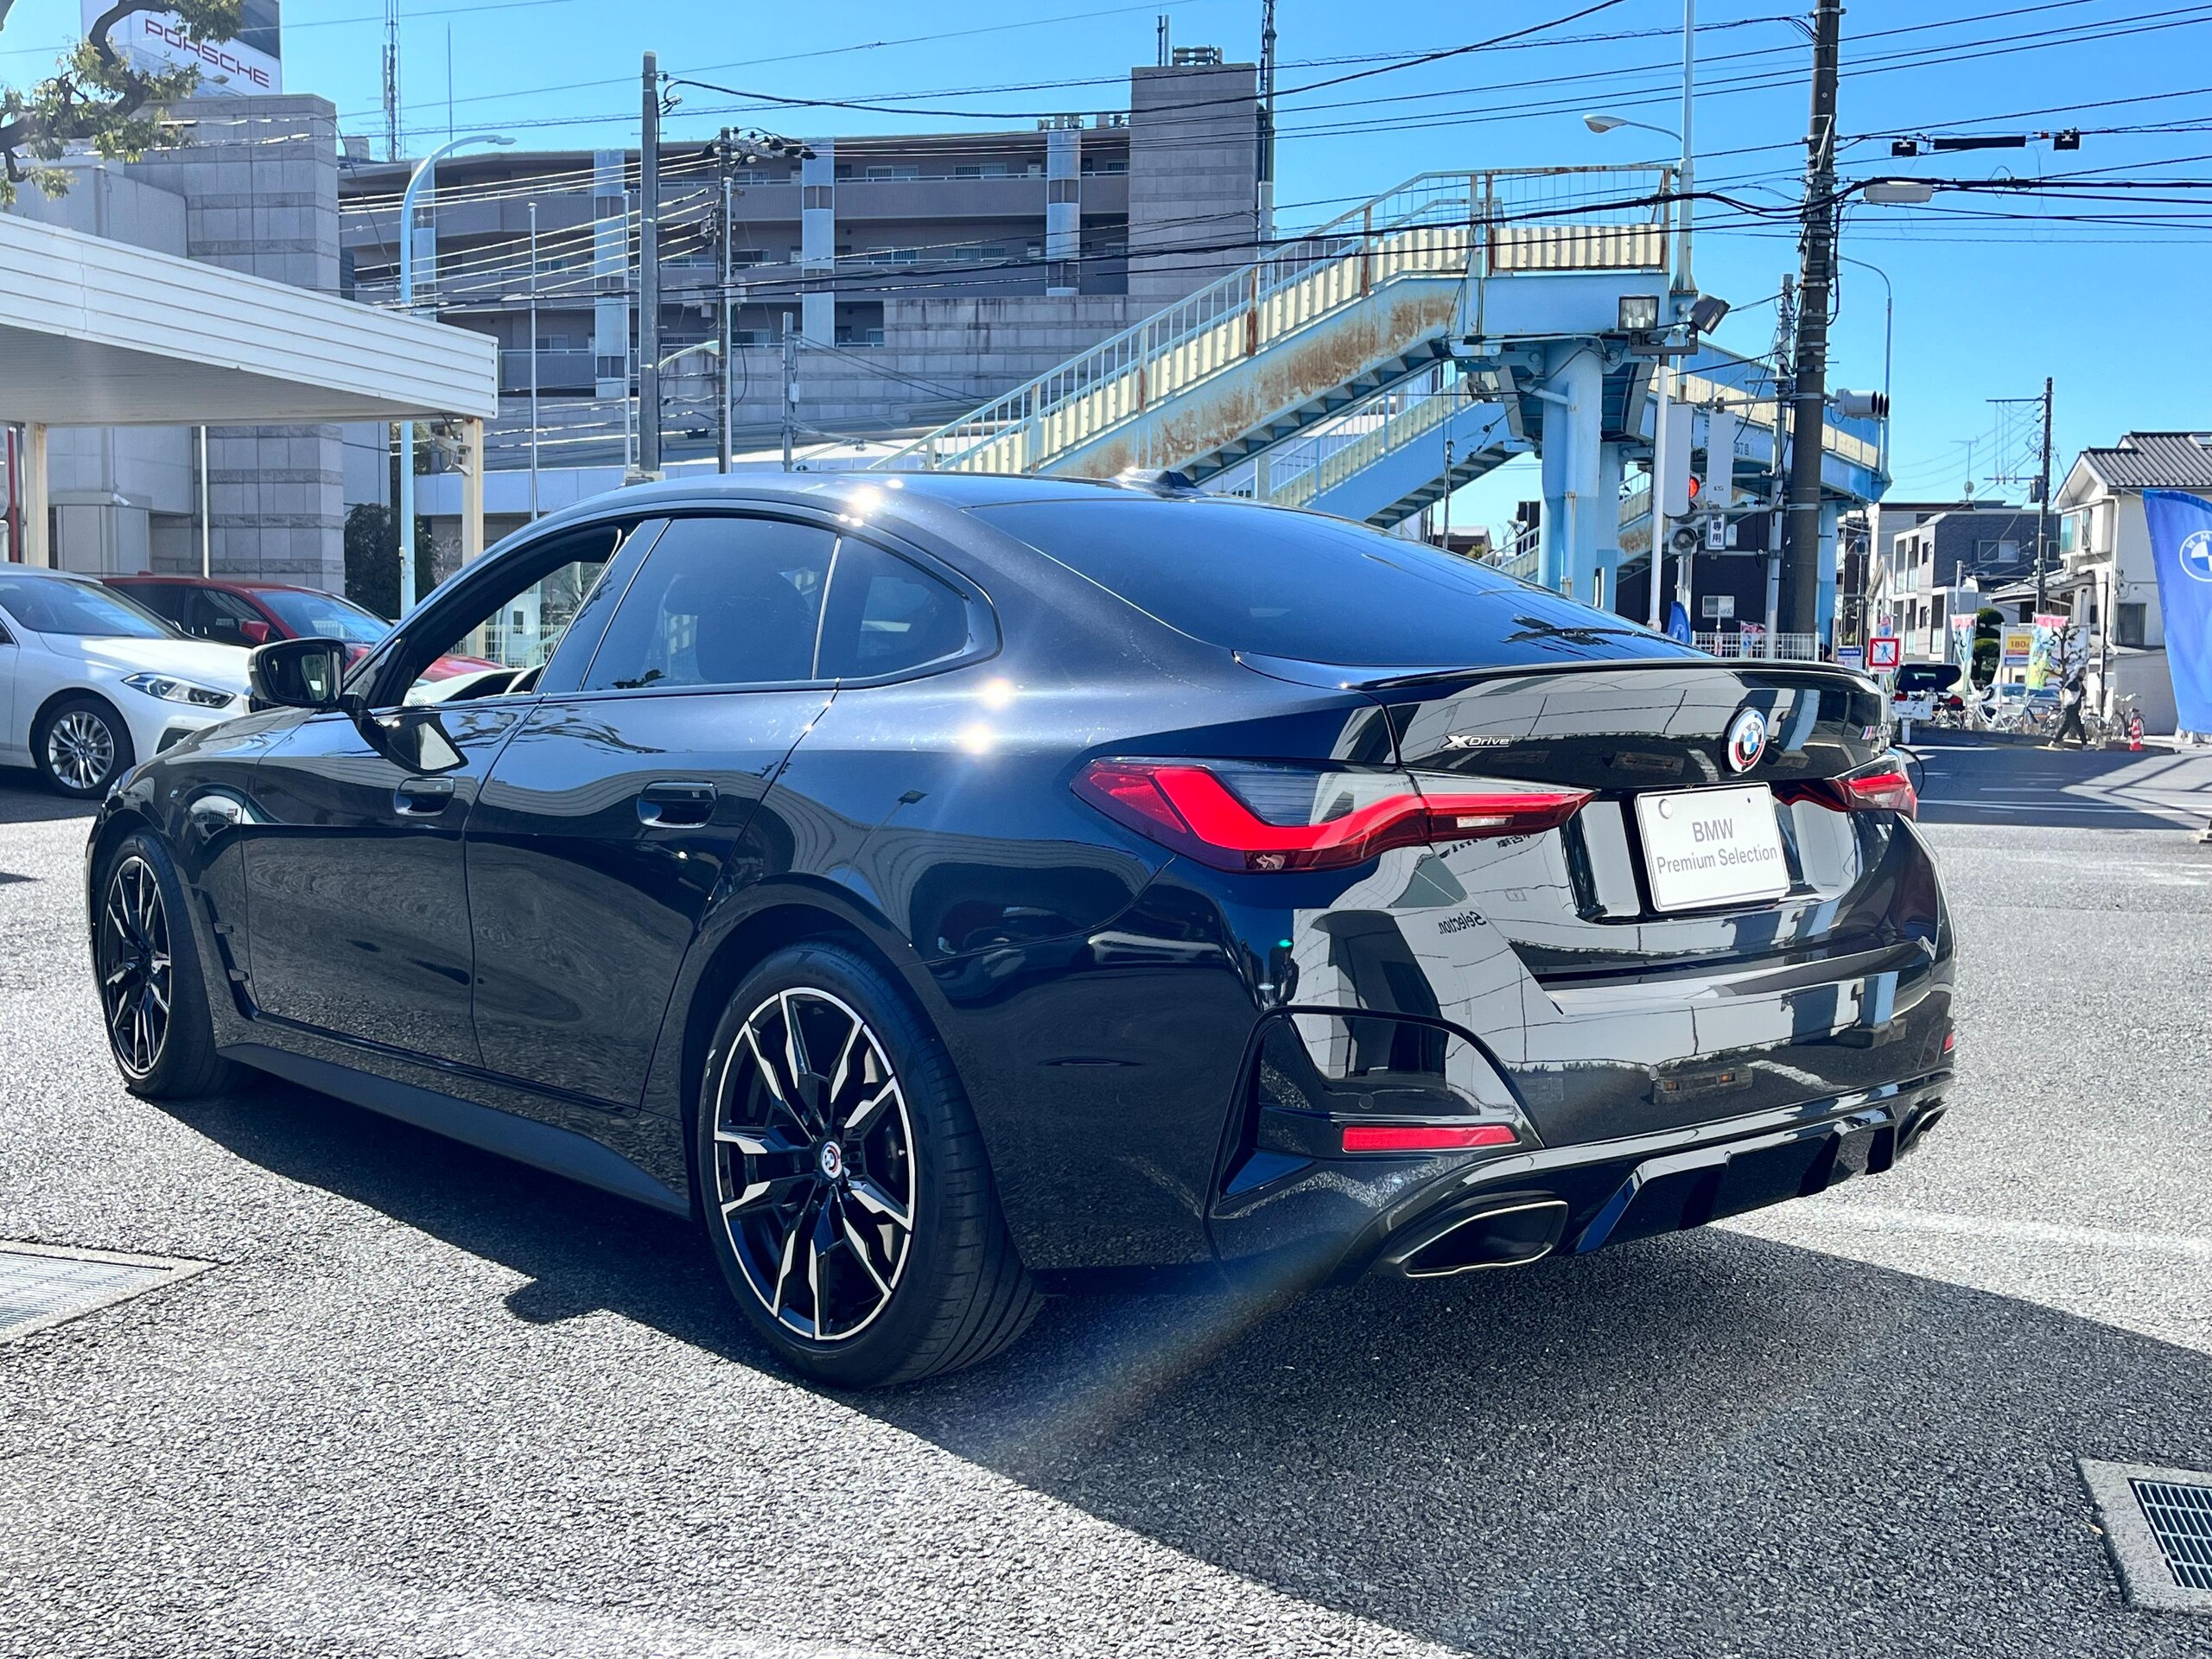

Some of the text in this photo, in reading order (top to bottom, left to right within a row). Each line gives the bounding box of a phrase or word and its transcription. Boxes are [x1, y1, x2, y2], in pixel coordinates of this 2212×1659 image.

[145, 18, 270, 88] PORSCHE
[1692, 818, 1734, 842] BMW
[1656, 843, 1778, 874] Premium Selection
